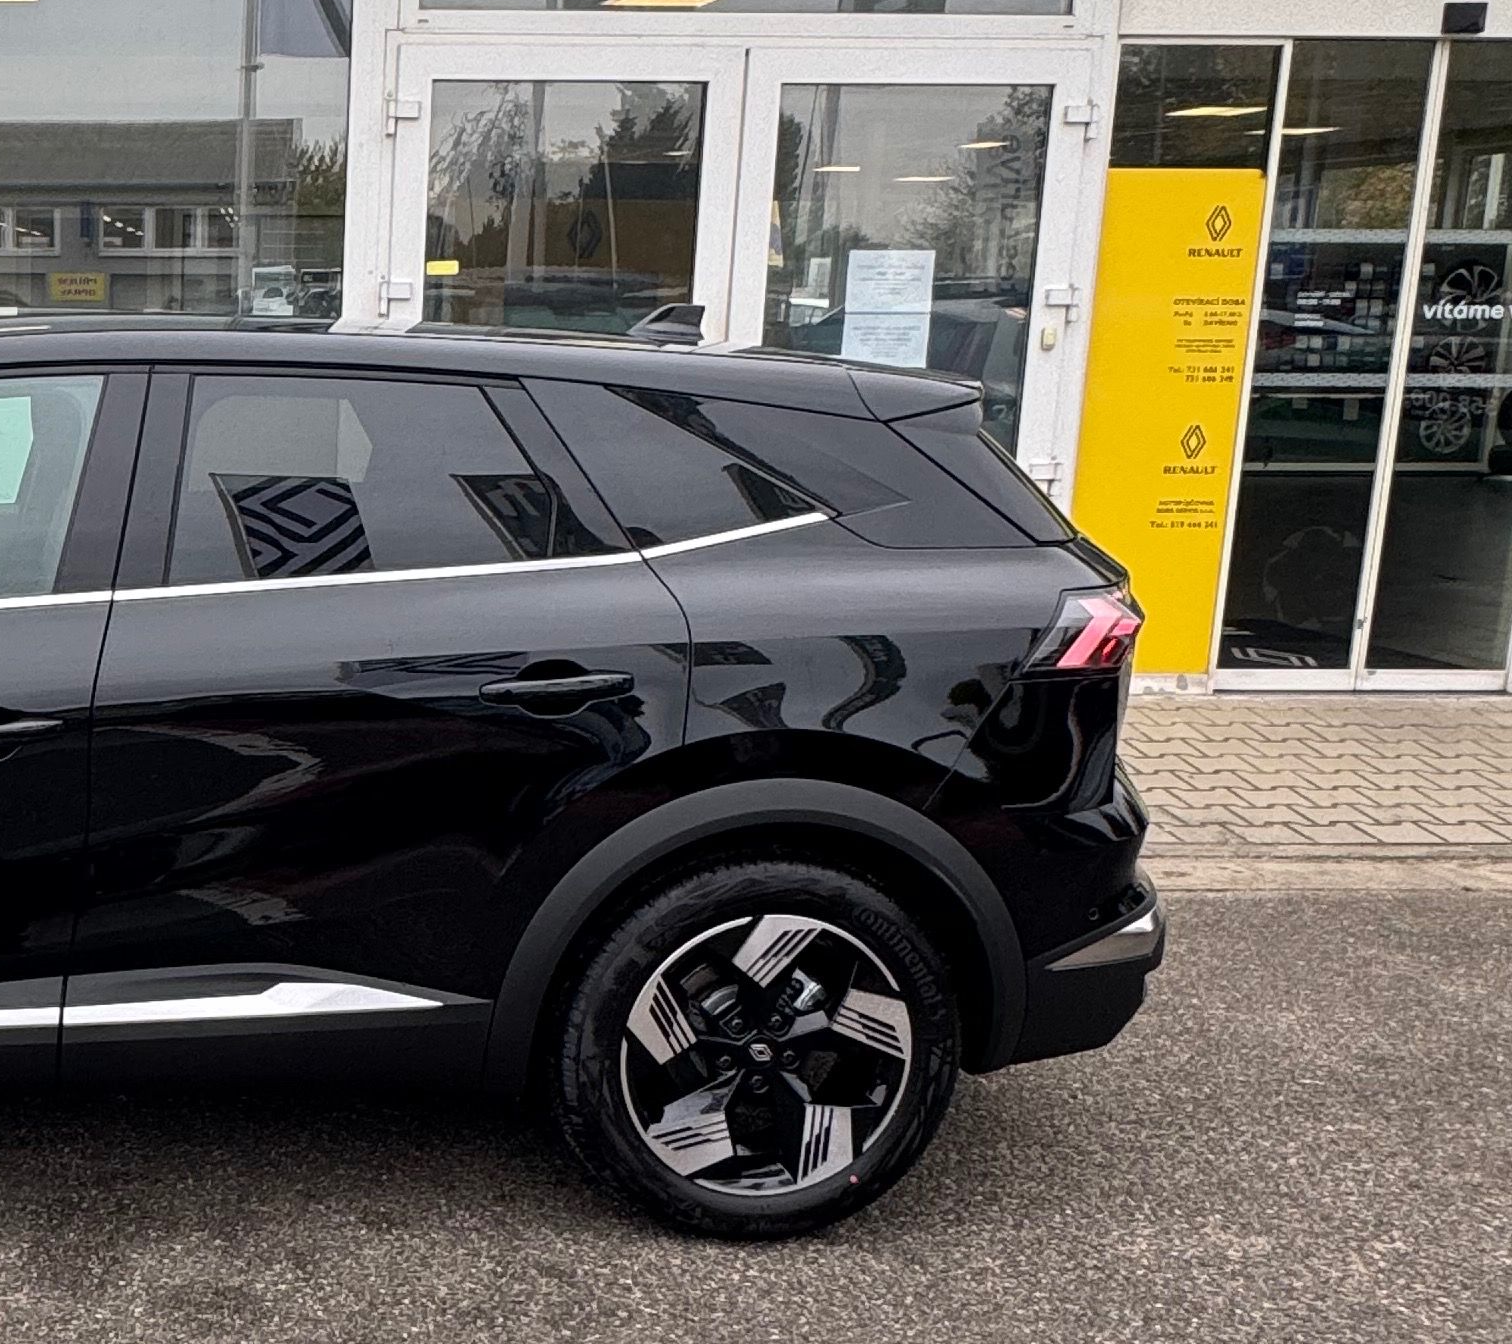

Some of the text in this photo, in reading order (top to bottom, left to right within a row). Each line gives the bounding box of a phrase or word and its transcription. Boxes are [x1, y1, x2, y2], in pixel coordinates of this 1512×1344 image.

[1187, 247, 1243, 258] RENAULT
[1422, 299, 1504, 320] vítáme
[1163, 465, 1218, 476] RENAULT
[850, 904, 943, 1007] Continental
